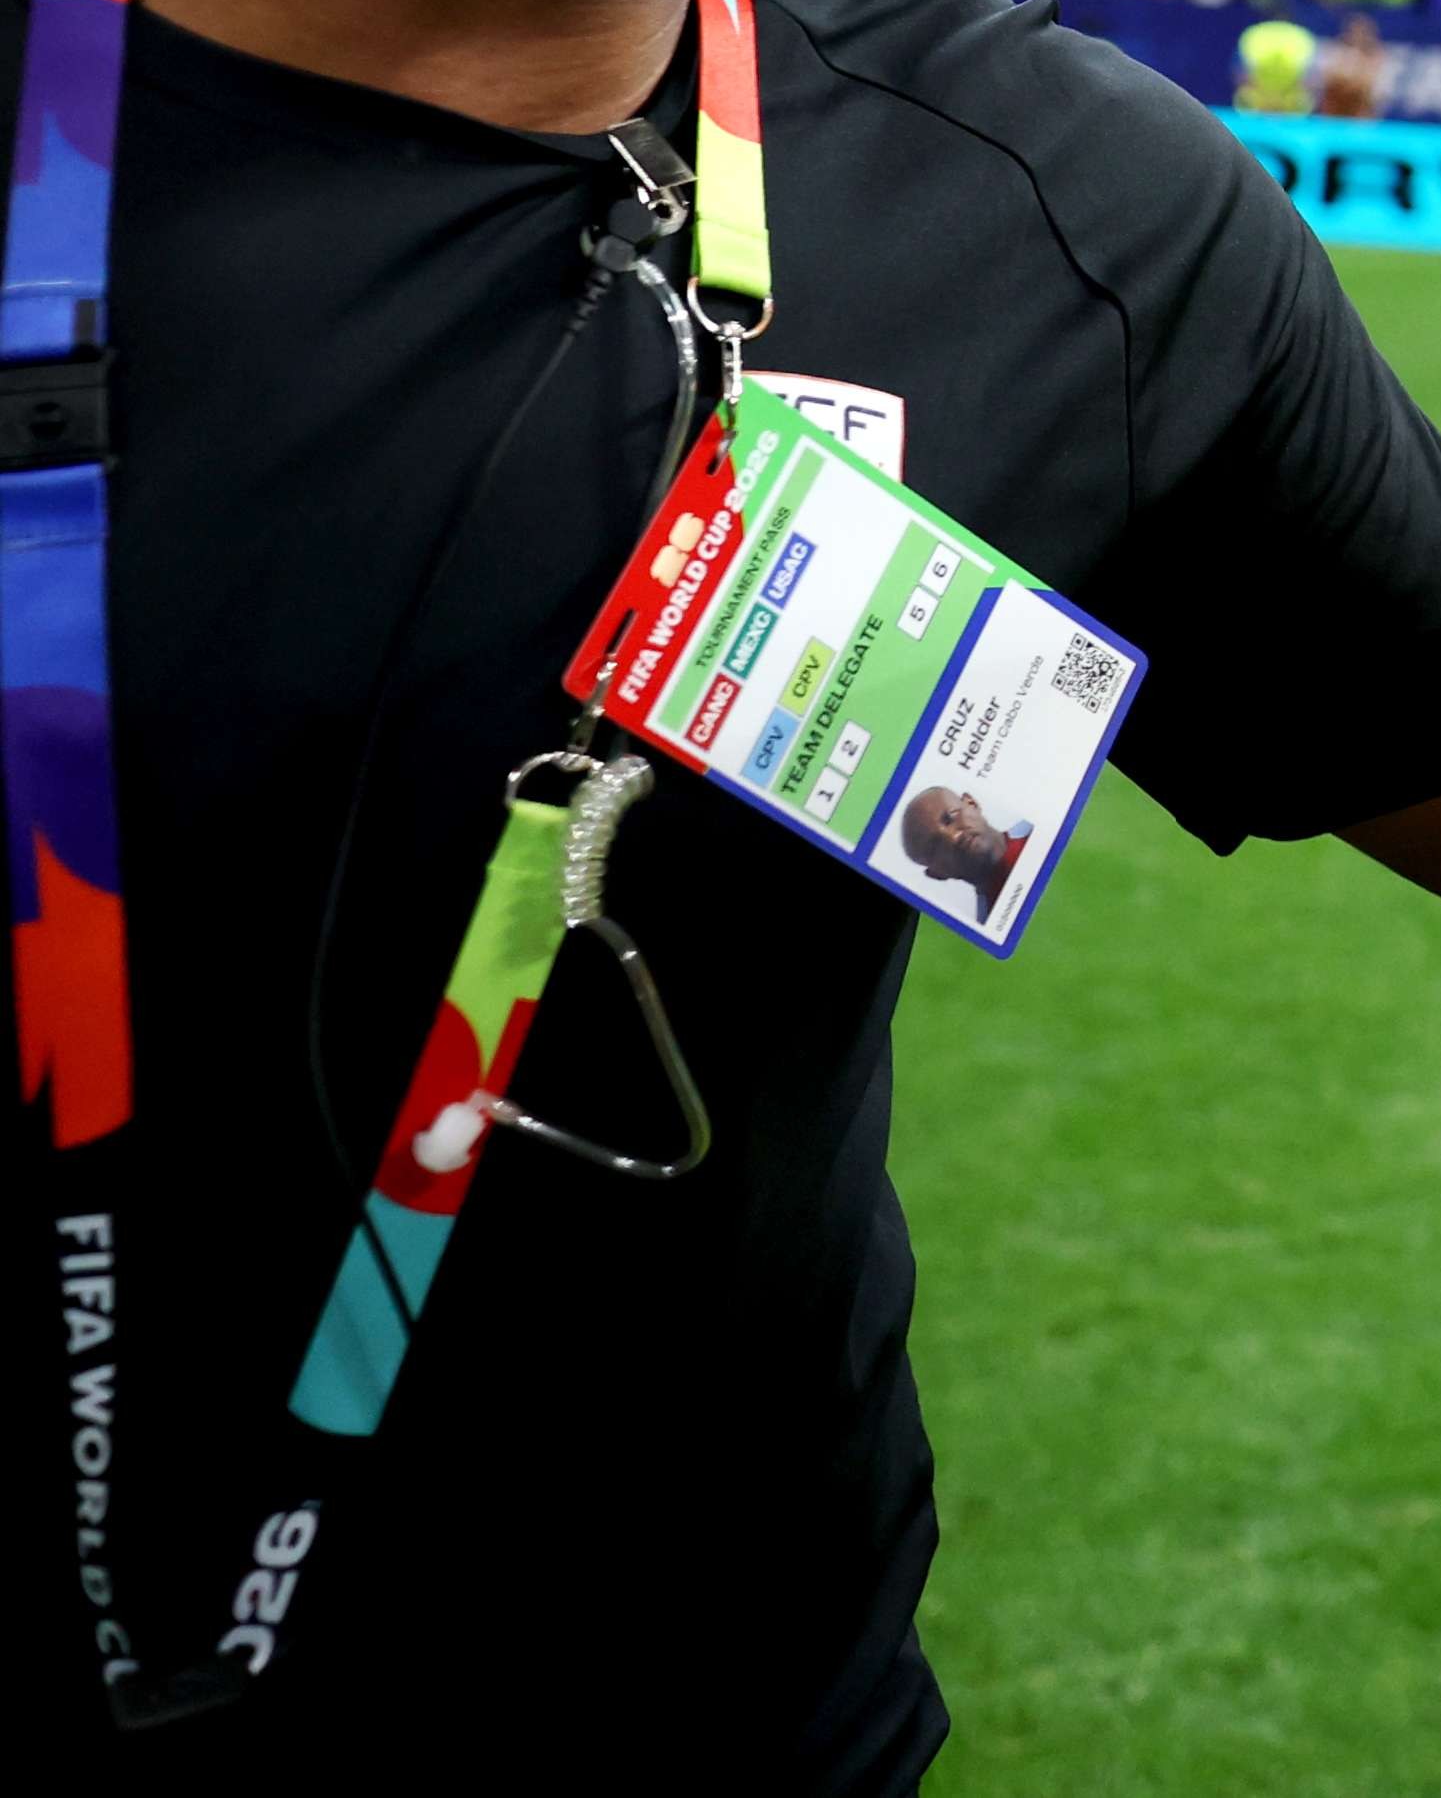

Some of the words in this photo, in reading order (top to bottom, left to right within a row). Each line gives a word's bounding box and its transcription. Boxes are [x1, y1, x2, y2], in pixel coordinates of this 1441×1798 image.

[618, 648, 662, 704] FIFA
[647, 560, 708, 647] WORLD
[697, 509, 734, 561] CUP
[724, 430, 779, 513] 2026
[697, 553, 764, 667] TOURNAMENT
[760, 507, 791, 550] PASS
[756, 725, 784, 769] CPV
[793, 655, 820, 698] CPV
[781, 728, 824, 794] TEAM
[818, 614, 884, 729] DELEGATE
[841, 739, 859, 757] 2
[909, 604, 927, 622] 5
[932, 561, 949, 579] 6
[938, 697, 975, 757] CRUZ
[958, 695, 1002, 770] Helder
[976, 739, 1004, 780] Team
[998, 699, 1022, 740] Cabo
[55, 1213, 116, 1355] FIFA
[69, 1363, 117, 1607] WORLD
